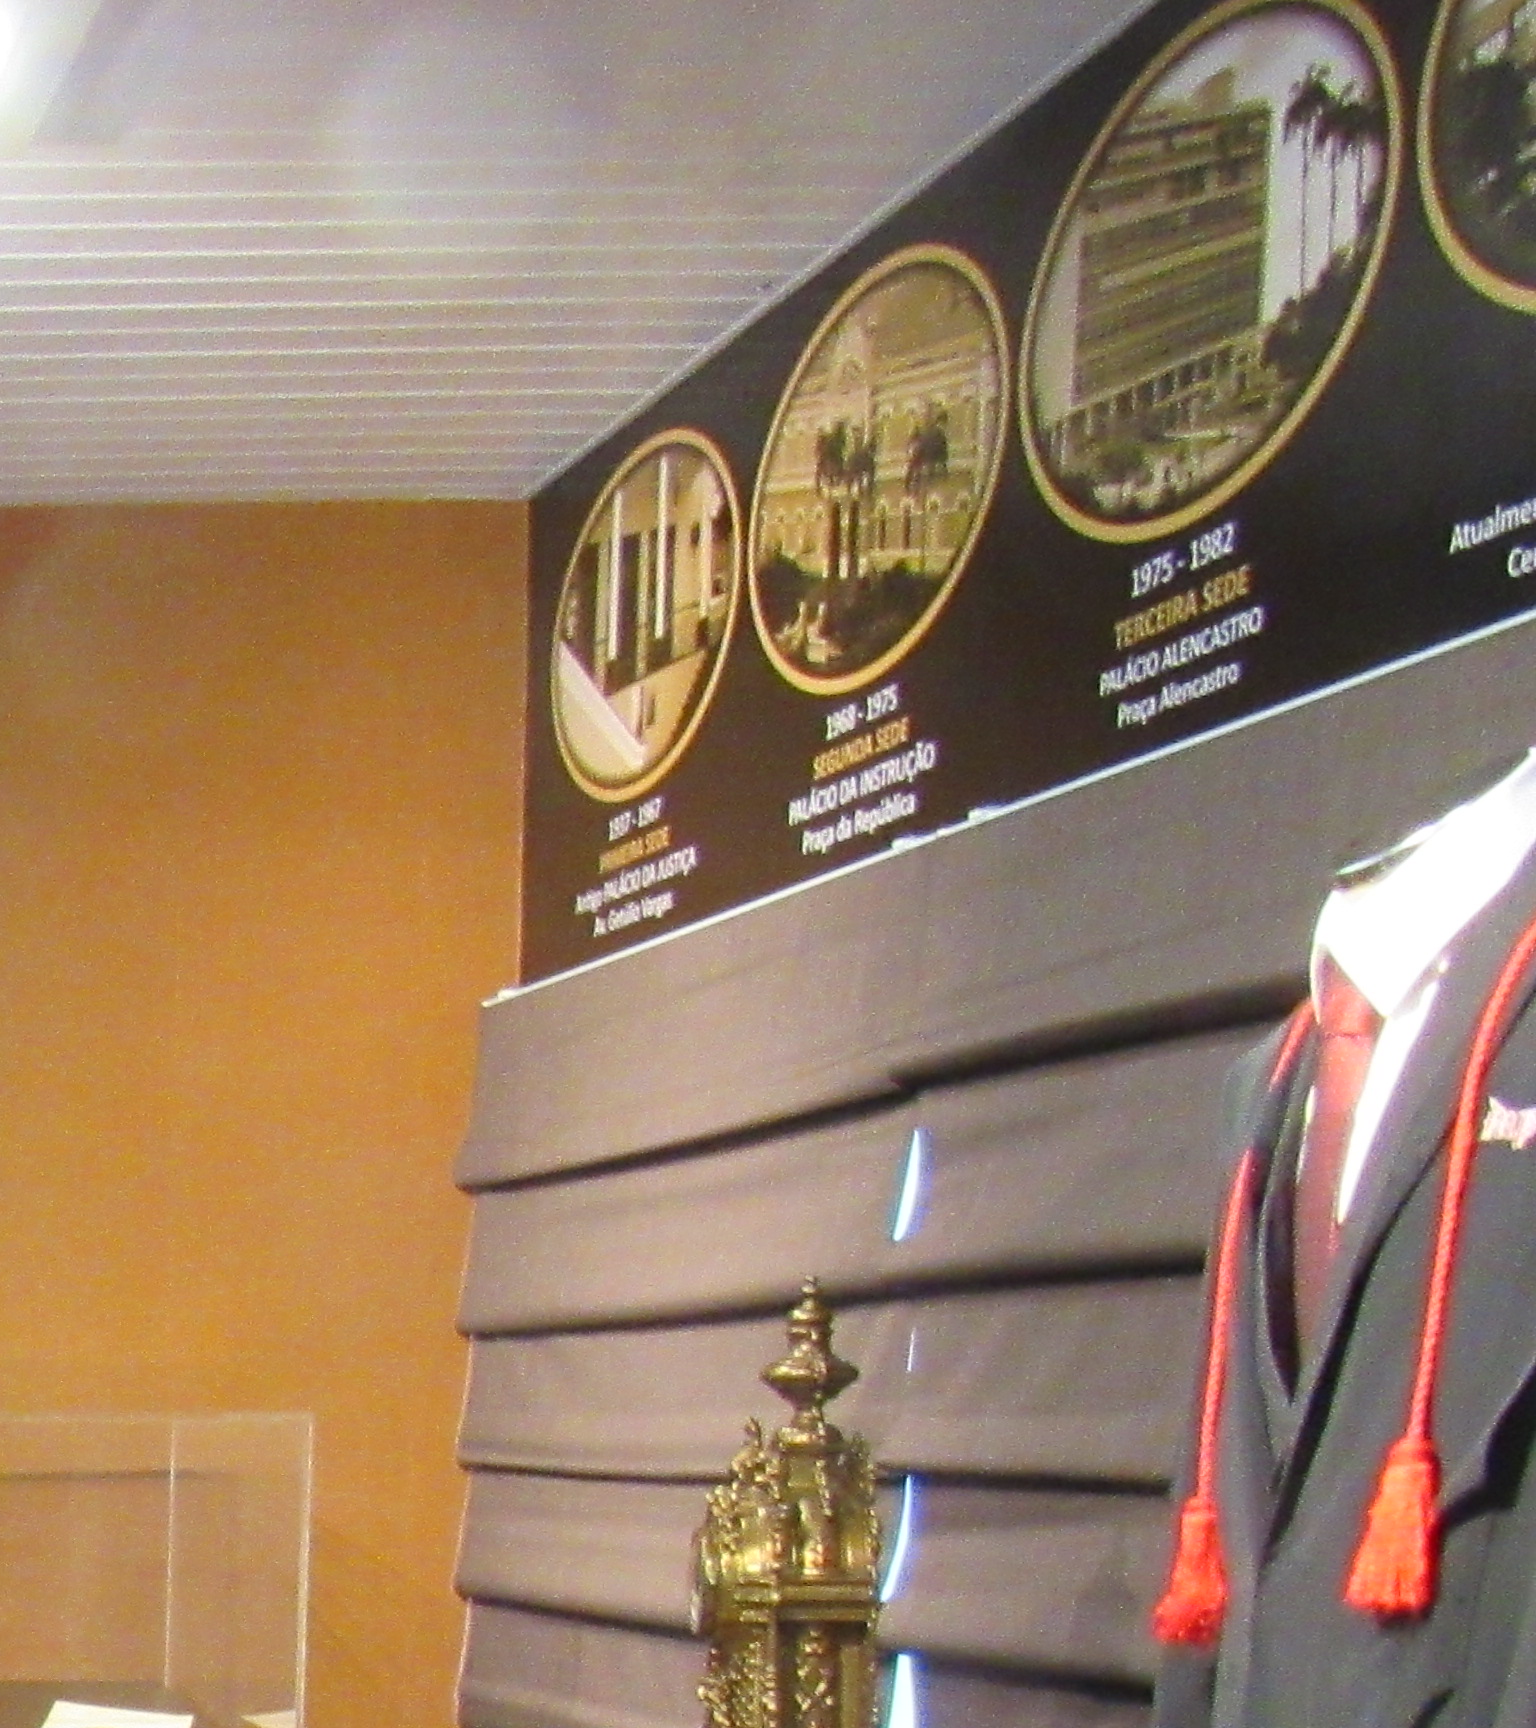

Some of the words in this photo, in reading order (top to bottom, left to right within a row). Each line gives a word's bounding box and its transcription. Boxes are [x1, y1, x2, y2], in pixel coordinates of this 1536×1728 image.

[1131, 552, 1175, 598] 1975
[1189, 521, 1236, 570] 1982
[1113, 588, 1199, 650] TERCEIRA
[1203, 564, 1252, 611] SEDE
[1099, 650, 1159, 697] PALÁCIO
[1162, 605, 1265, 670] ALENCASTRO
[866, 683, 898, 721] 1975
[1117, 697, 1156, 728] Praça
[1159, 662, 1242, 710] Alencastro
[788, 783, 838, 827] PALÁCIO
[859, 740, 937, 798] INSTRUÇÃO
